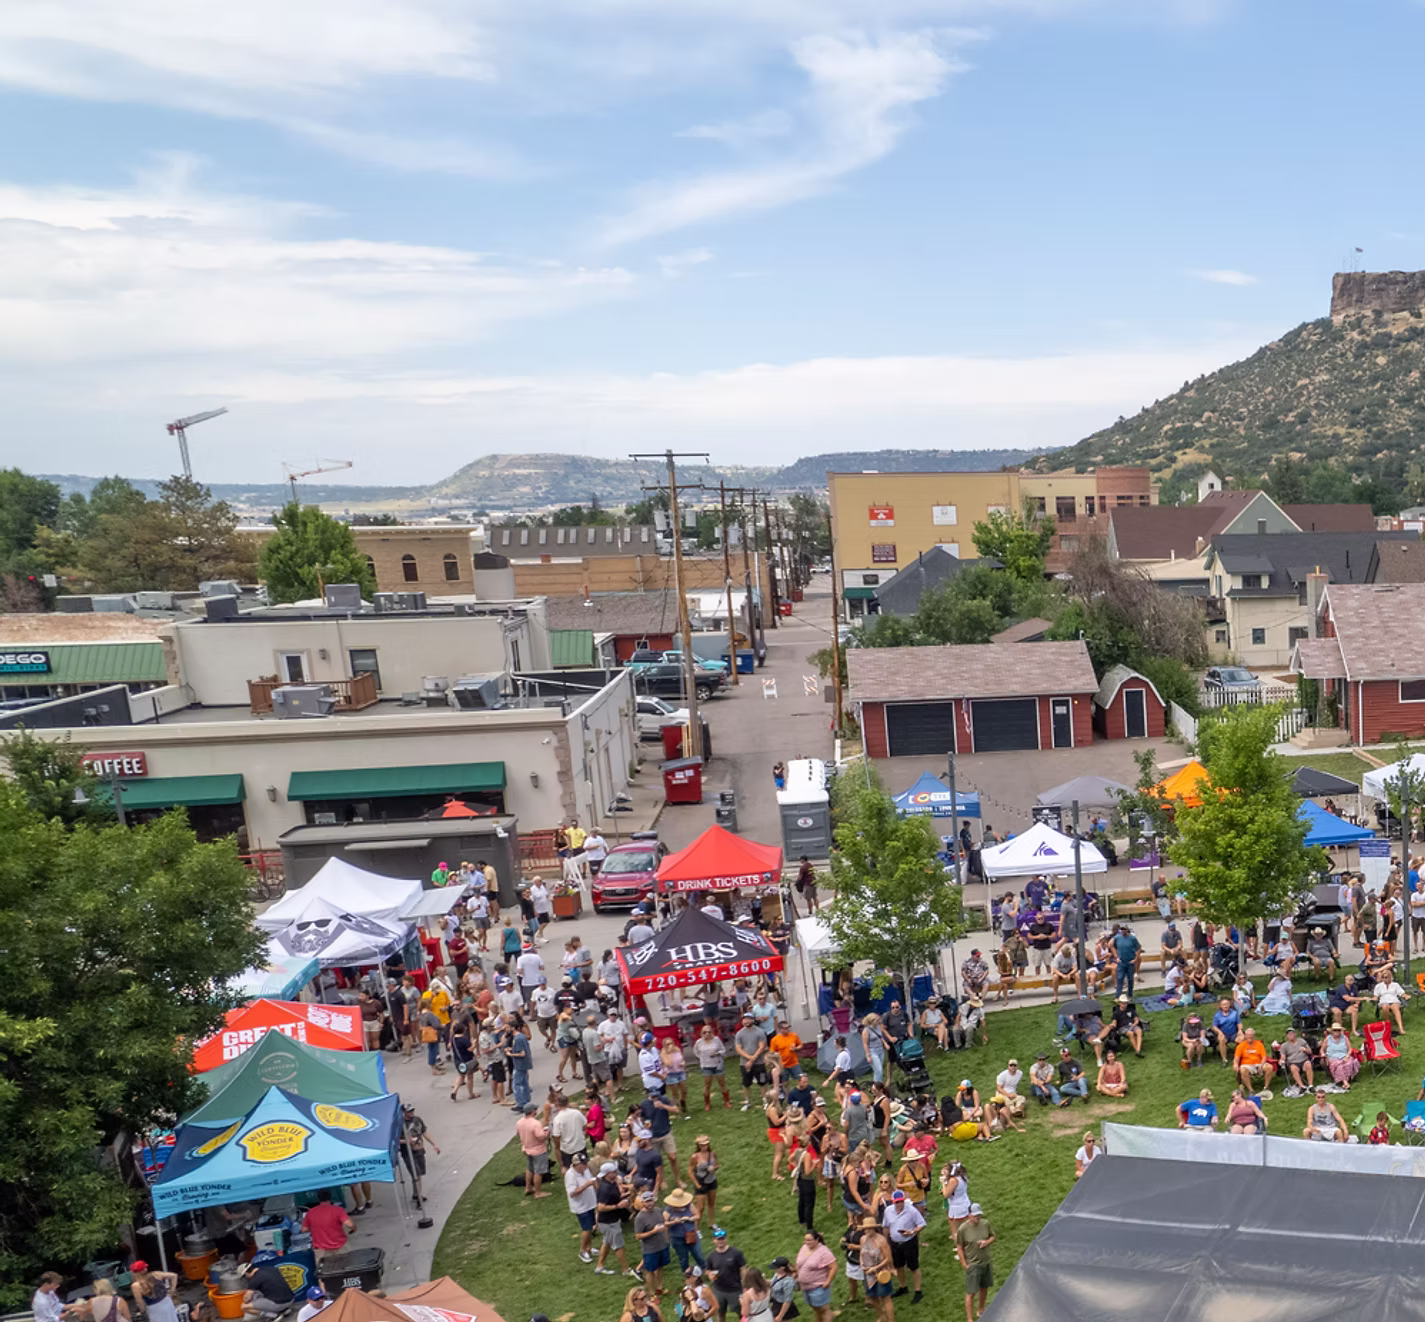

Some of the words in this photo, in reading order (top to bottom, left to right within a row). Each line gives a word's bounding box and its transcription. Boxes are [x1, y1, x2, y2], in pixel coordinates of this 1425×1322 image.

[82, 758, 144, 775] COFFEE
[677, 878, 712, 891] DRINK
[714, 874, 760, 888] TICKETS
[666, 941, 739, 962] HBS
[644, 959, 771, 990] 720-547-8600
[248, 1127, 274, 1142] WILD
[256, 1135, 294, 1147] YONDER
[338, 1160, 356, 1169] BLUE
[180, 1186, 199, 1194] BLUE
[201, 1183, 232, 1191] YONDER
